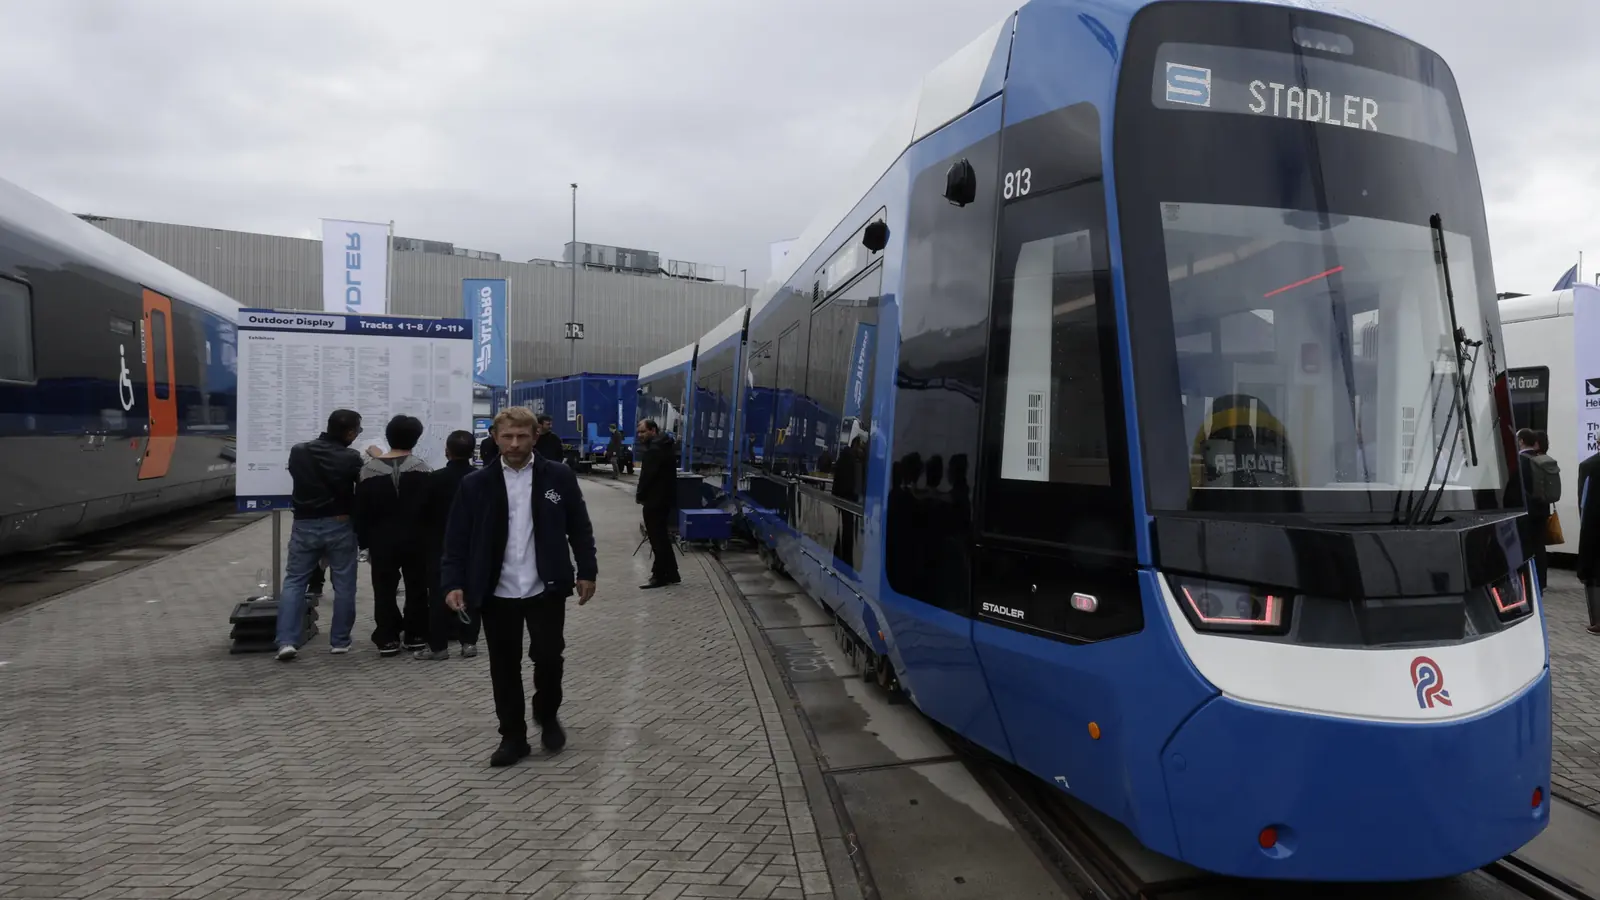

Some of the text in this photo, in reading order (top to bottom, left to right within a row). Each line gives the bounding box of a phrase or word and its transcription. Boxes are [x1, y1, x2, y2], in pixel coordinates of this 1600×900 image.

[1249, 80, 1379, 132] STADLER
[1003, 167, 1032, 199] 813
[249, 316, 335, 328] Outdoor Display
[360, 321, 393, 330] Tracks
[1518, 376, 1539, 389] Group
[982, 602, 1025, 620] STADLER
